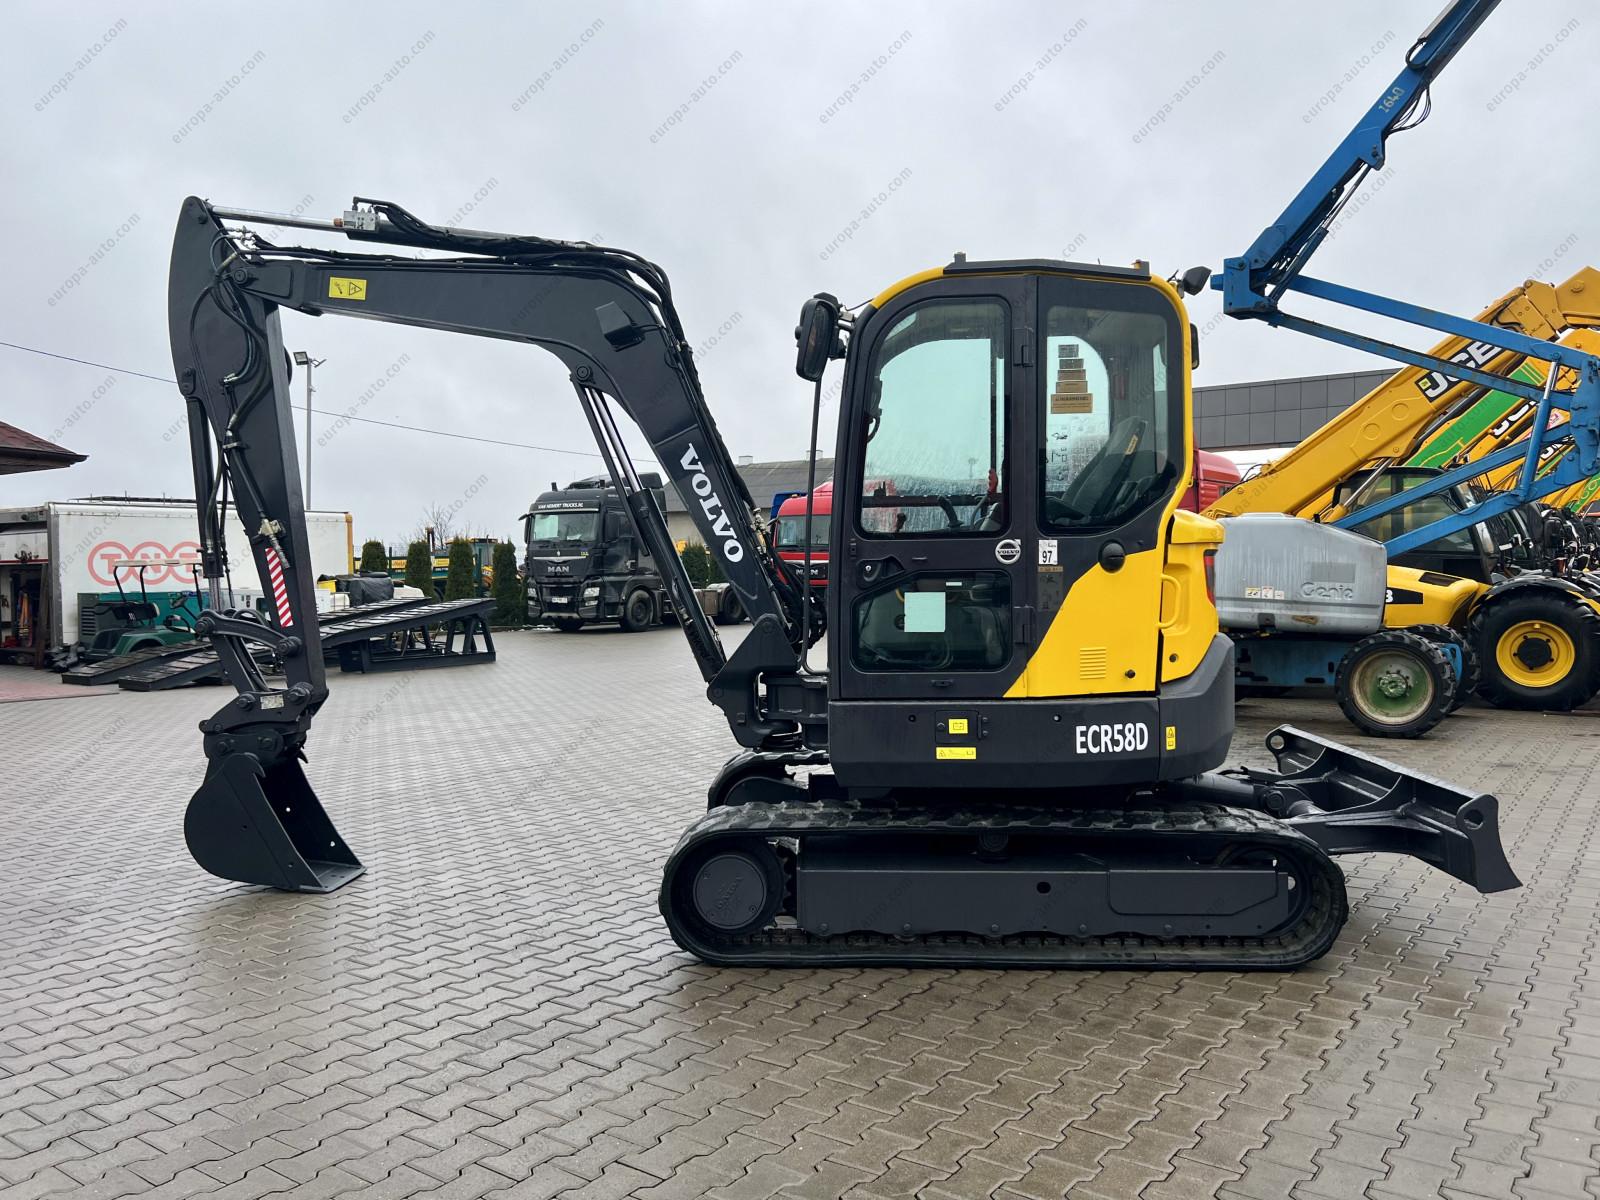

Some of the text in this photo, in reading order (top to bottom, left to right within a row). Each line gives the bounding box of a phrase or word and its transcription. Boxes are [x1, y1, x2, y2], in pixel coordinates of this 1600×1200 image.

[1379, 87, 1405, 112] 1640
[680, 442, 744, 563] VOLVO
[1042, 550, 1053, 563] 97
[1301, 581, 1354, 599] Genie
[1075, 722, 1149, 754] ECR58D
